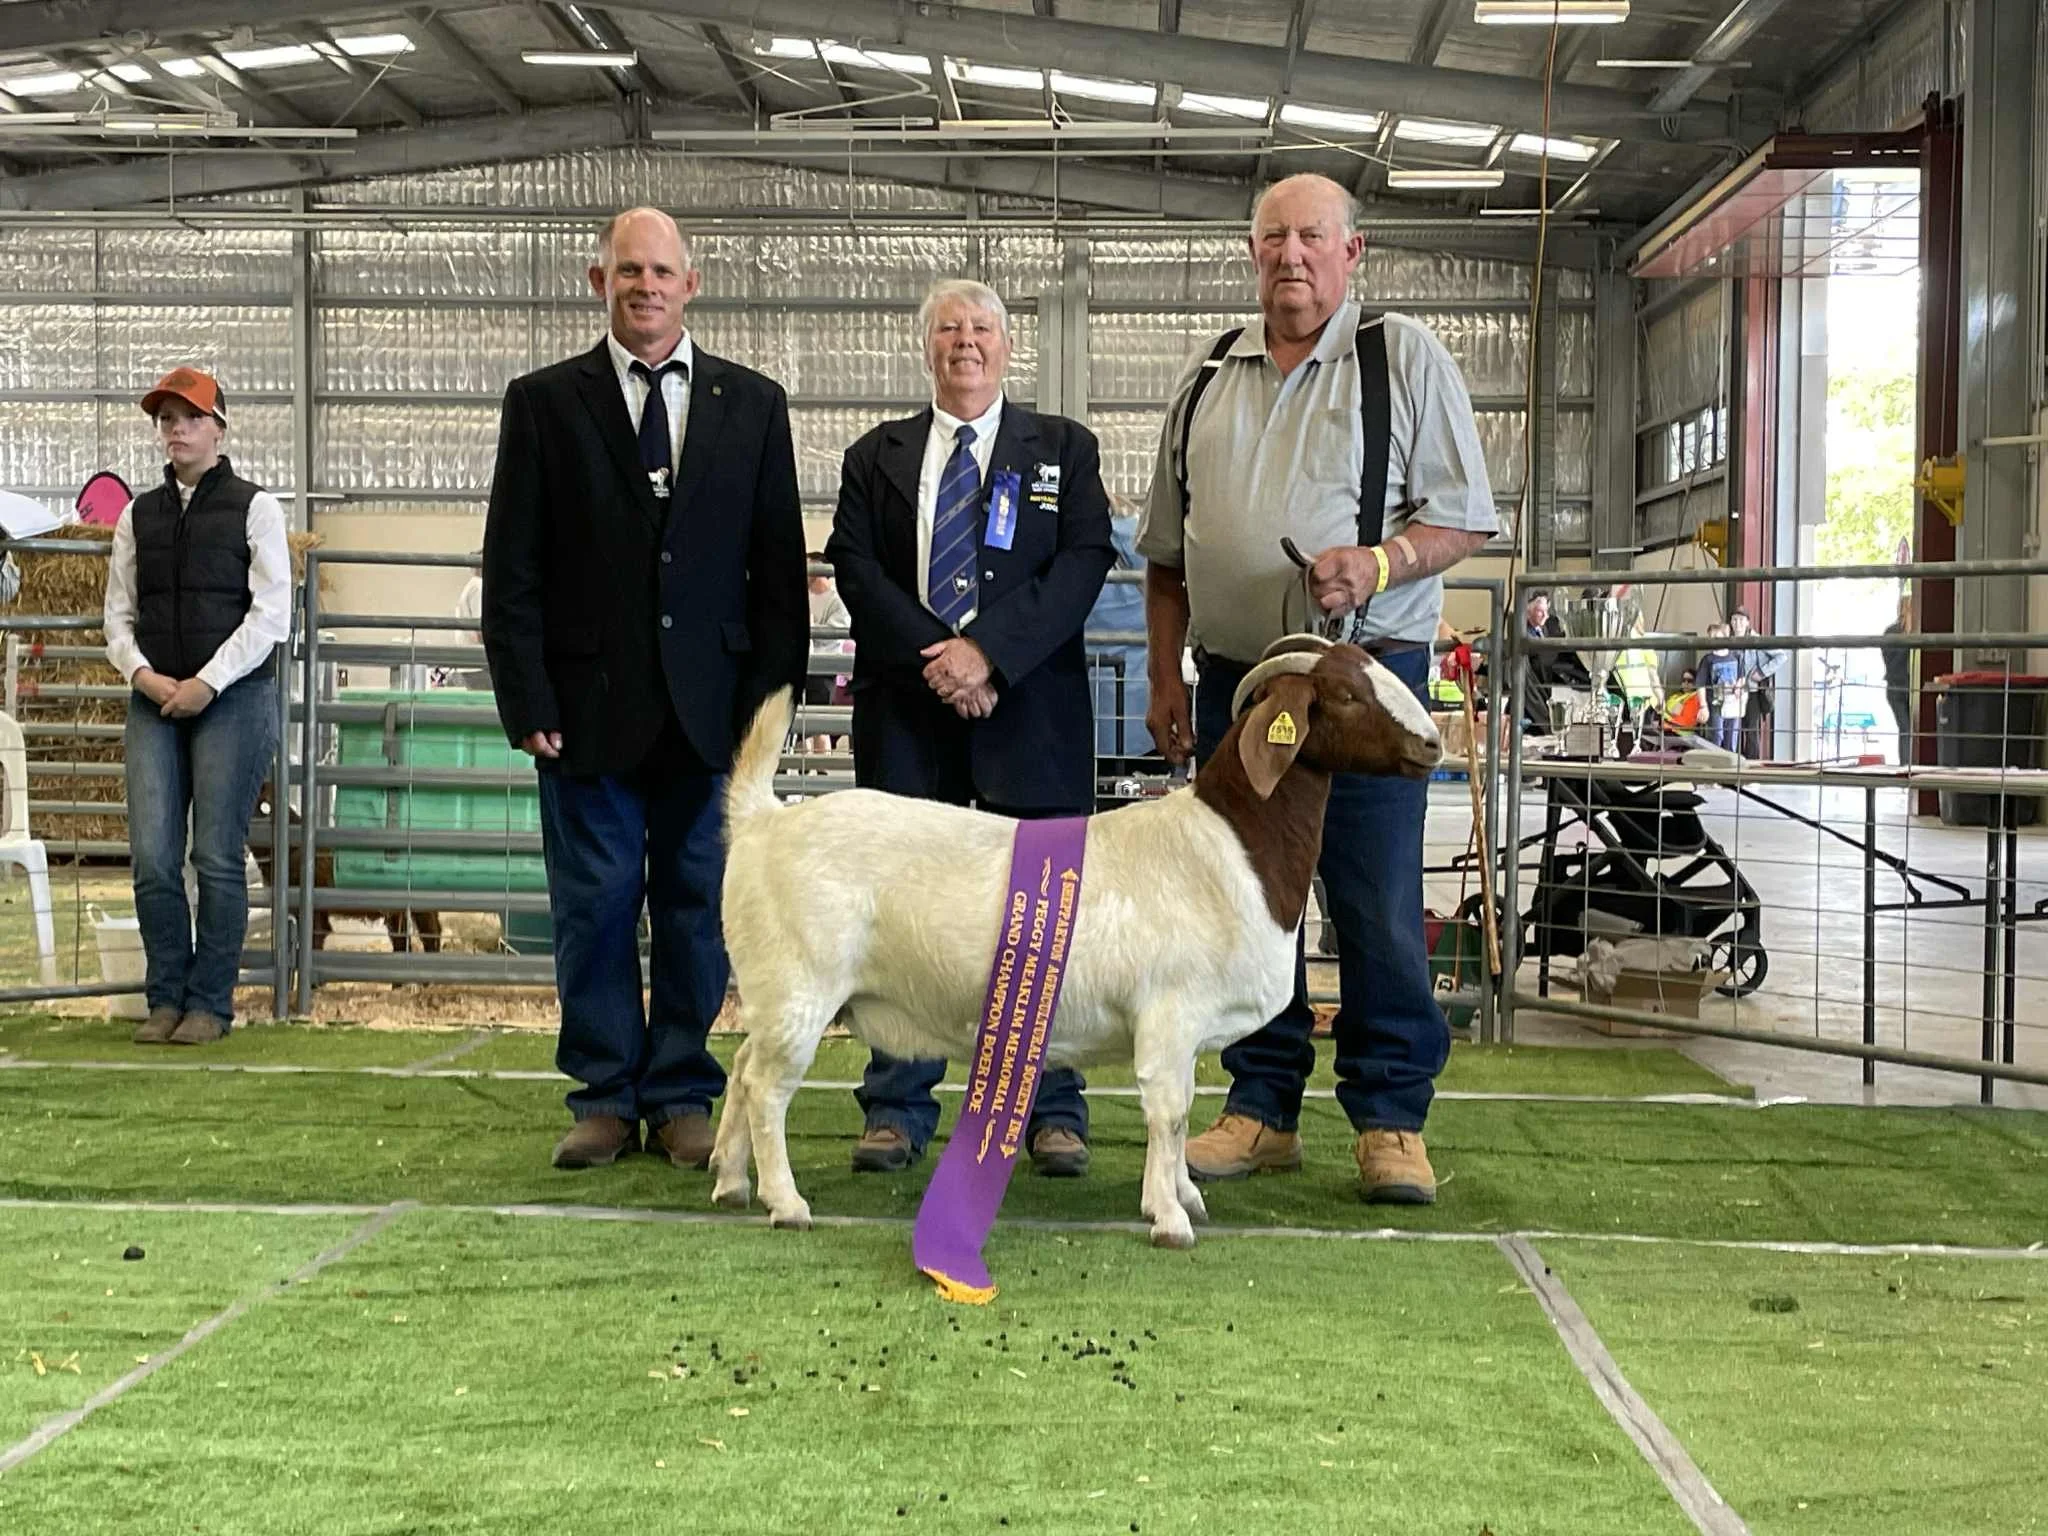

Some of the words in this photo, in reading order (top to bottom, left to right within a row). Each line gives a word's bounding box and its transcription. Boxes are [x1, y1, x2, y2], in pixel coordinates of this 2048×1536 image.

[1006, 891, 1028, 946] GRAND
[1029, 898, 1049, 953] PEGGY
[1050, 882, 1075, 962] SHEPPARTON
[985, 948, 1017, 1032] CHAMPION
[1010, 953, 1040, 1028] MEAKLIM
[1027, 965, 1060, 1063] AGRICULTURAL
[976, 1033, 997, 1077] BOER
[990, 1030, 1021, 1115] MEMORIAL
[968, 1078, 987, 1114] DOE
[1014, 1064, 1037, 1118] SOCIETY
